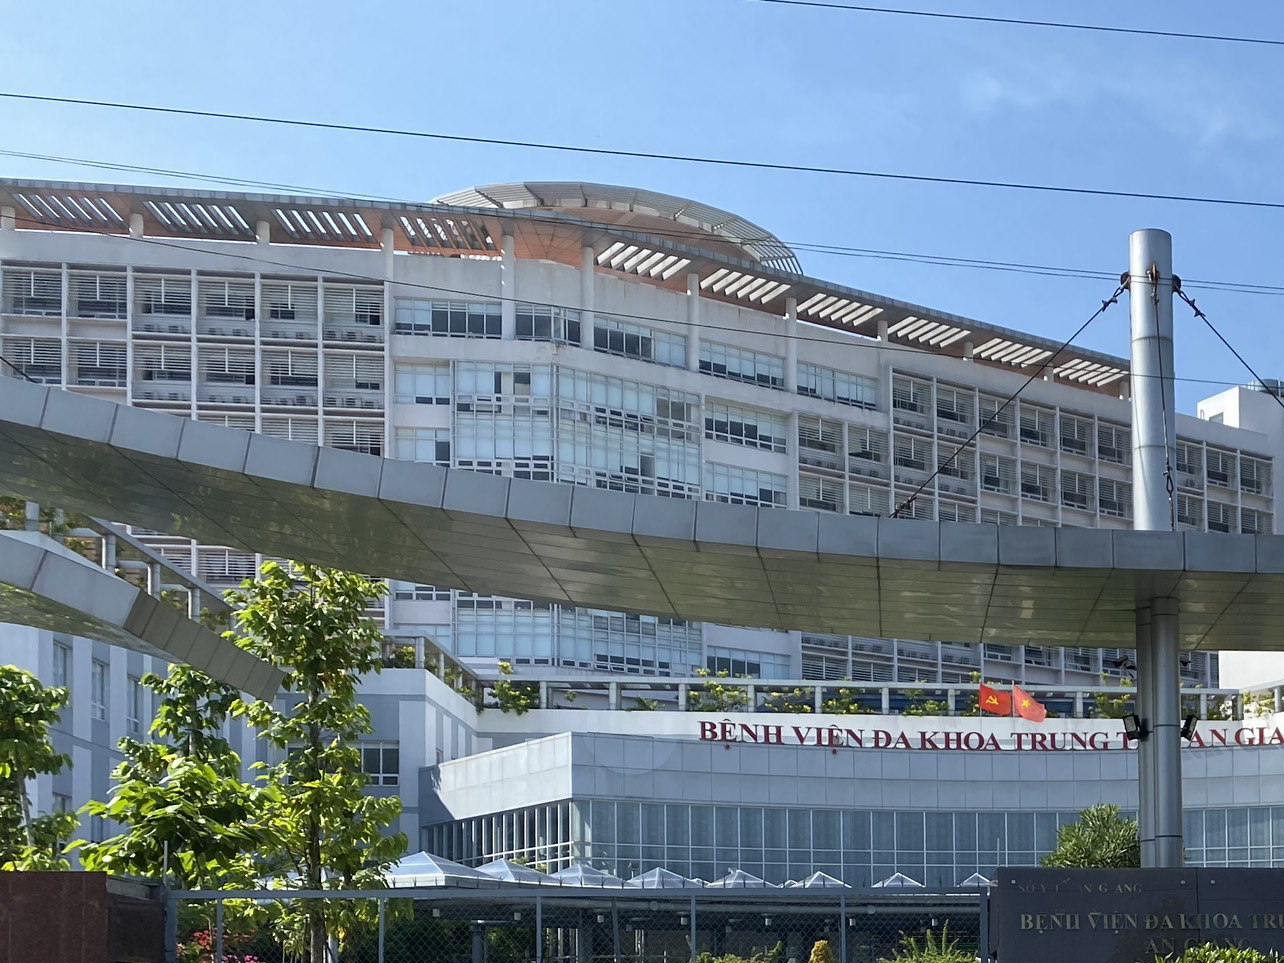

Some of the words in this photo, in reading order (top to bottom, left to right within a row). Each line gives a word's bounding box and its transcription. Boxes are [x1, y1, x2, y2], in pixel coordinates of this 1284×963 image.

[698, 718, 783, 750] BỆNH
[791, 724, 864, 754] VIỆN
[871, 730, 912, 749] ĐA
[916, 730, 1002, 751] KHOA
[1010, 731, 1110, 751] TRUNG
[1188, 728, 1228, 748] AN
[1144, 913, 1175, 930] ĐA
[1179, 913, 1243, 930] KHOA
[1145, 938, 1176, 954] AN
